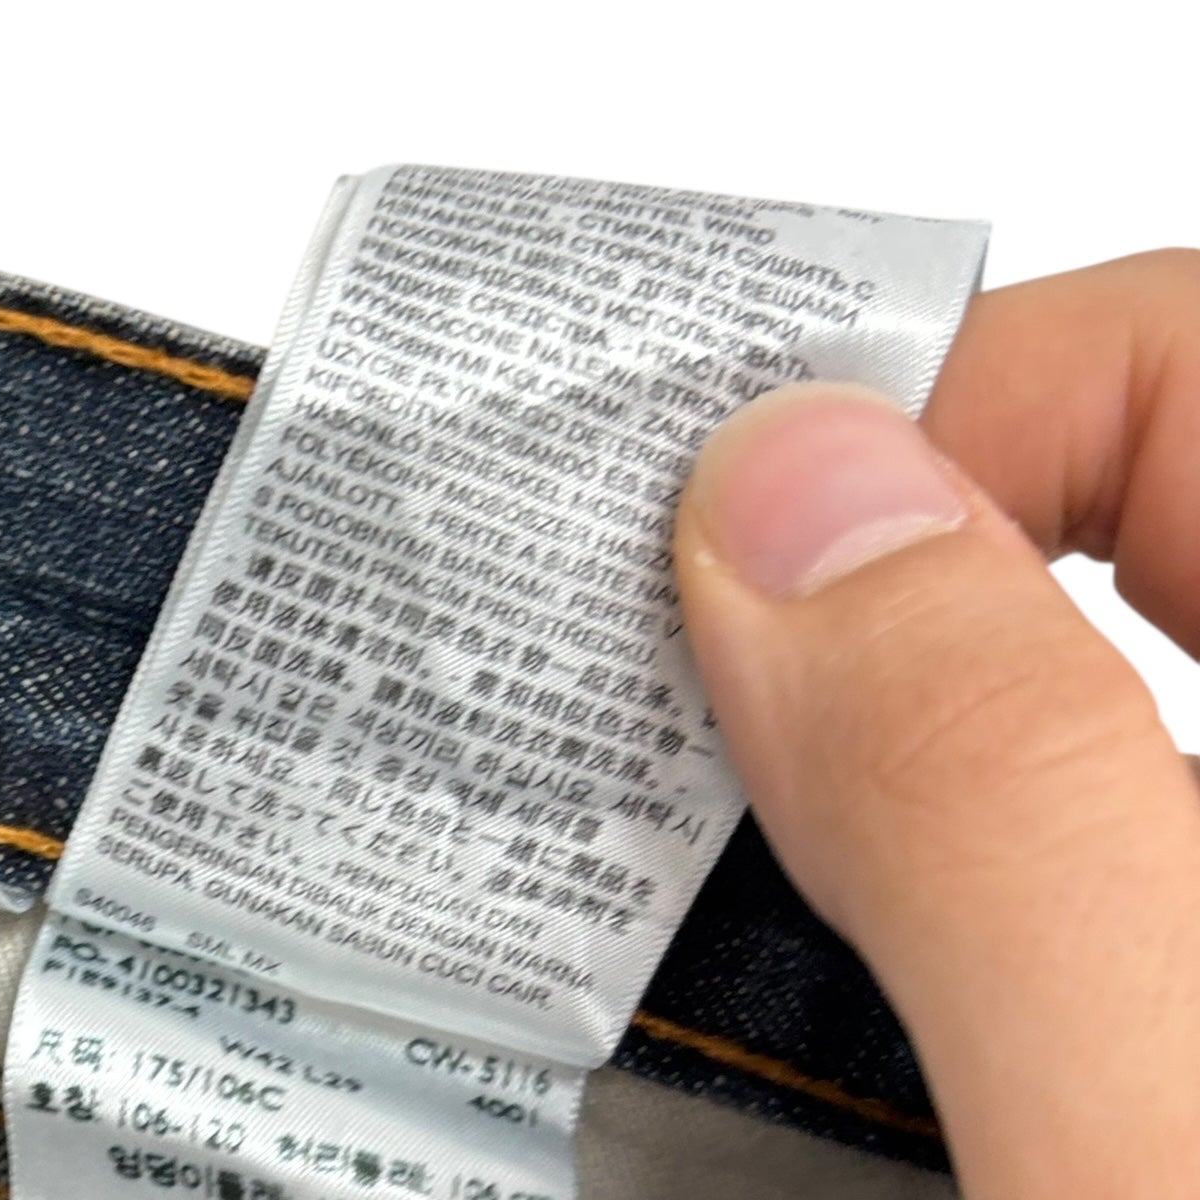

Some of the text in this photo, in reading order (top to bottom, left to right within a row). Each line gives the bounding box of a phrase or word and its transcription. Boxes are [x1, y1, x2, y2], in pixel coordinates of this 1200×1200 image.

[365, 215, 510, 260] ПОХОЖИХ
[576, 212, 703, 253] СТИРАТЬ
[706, 241, 731, 259] И
[732, 246, 853, 291] СУШИТЬ
[849, 278, 878, 300] С
[700, 216, 777, 246] WIRD
[567, 234, 707, 281] СТОРОНЫ
[709, 269, 737, 289] С
[280, 424, 439, 493] FOLYÉKONY
[239, 514, 365, 573] TEKUTÉM
[177, 648, 272, 701] 세탁시
[204, 876, 325, 934] GUNAKAN
[326, 922, 416, 966] SABUN
[417, 951, 485, 986] CUCI
[387, 909, 498, 959] DENGAN
[53, 934, 298, 1024] PO-4100321343
[131, 1052, 285, 1112] 175/106C
[219, 1035, 294, 1076] W42
[404, 1037, 552, 1096] CW-5116
[116, 1098, 246, 1154] 106-120
